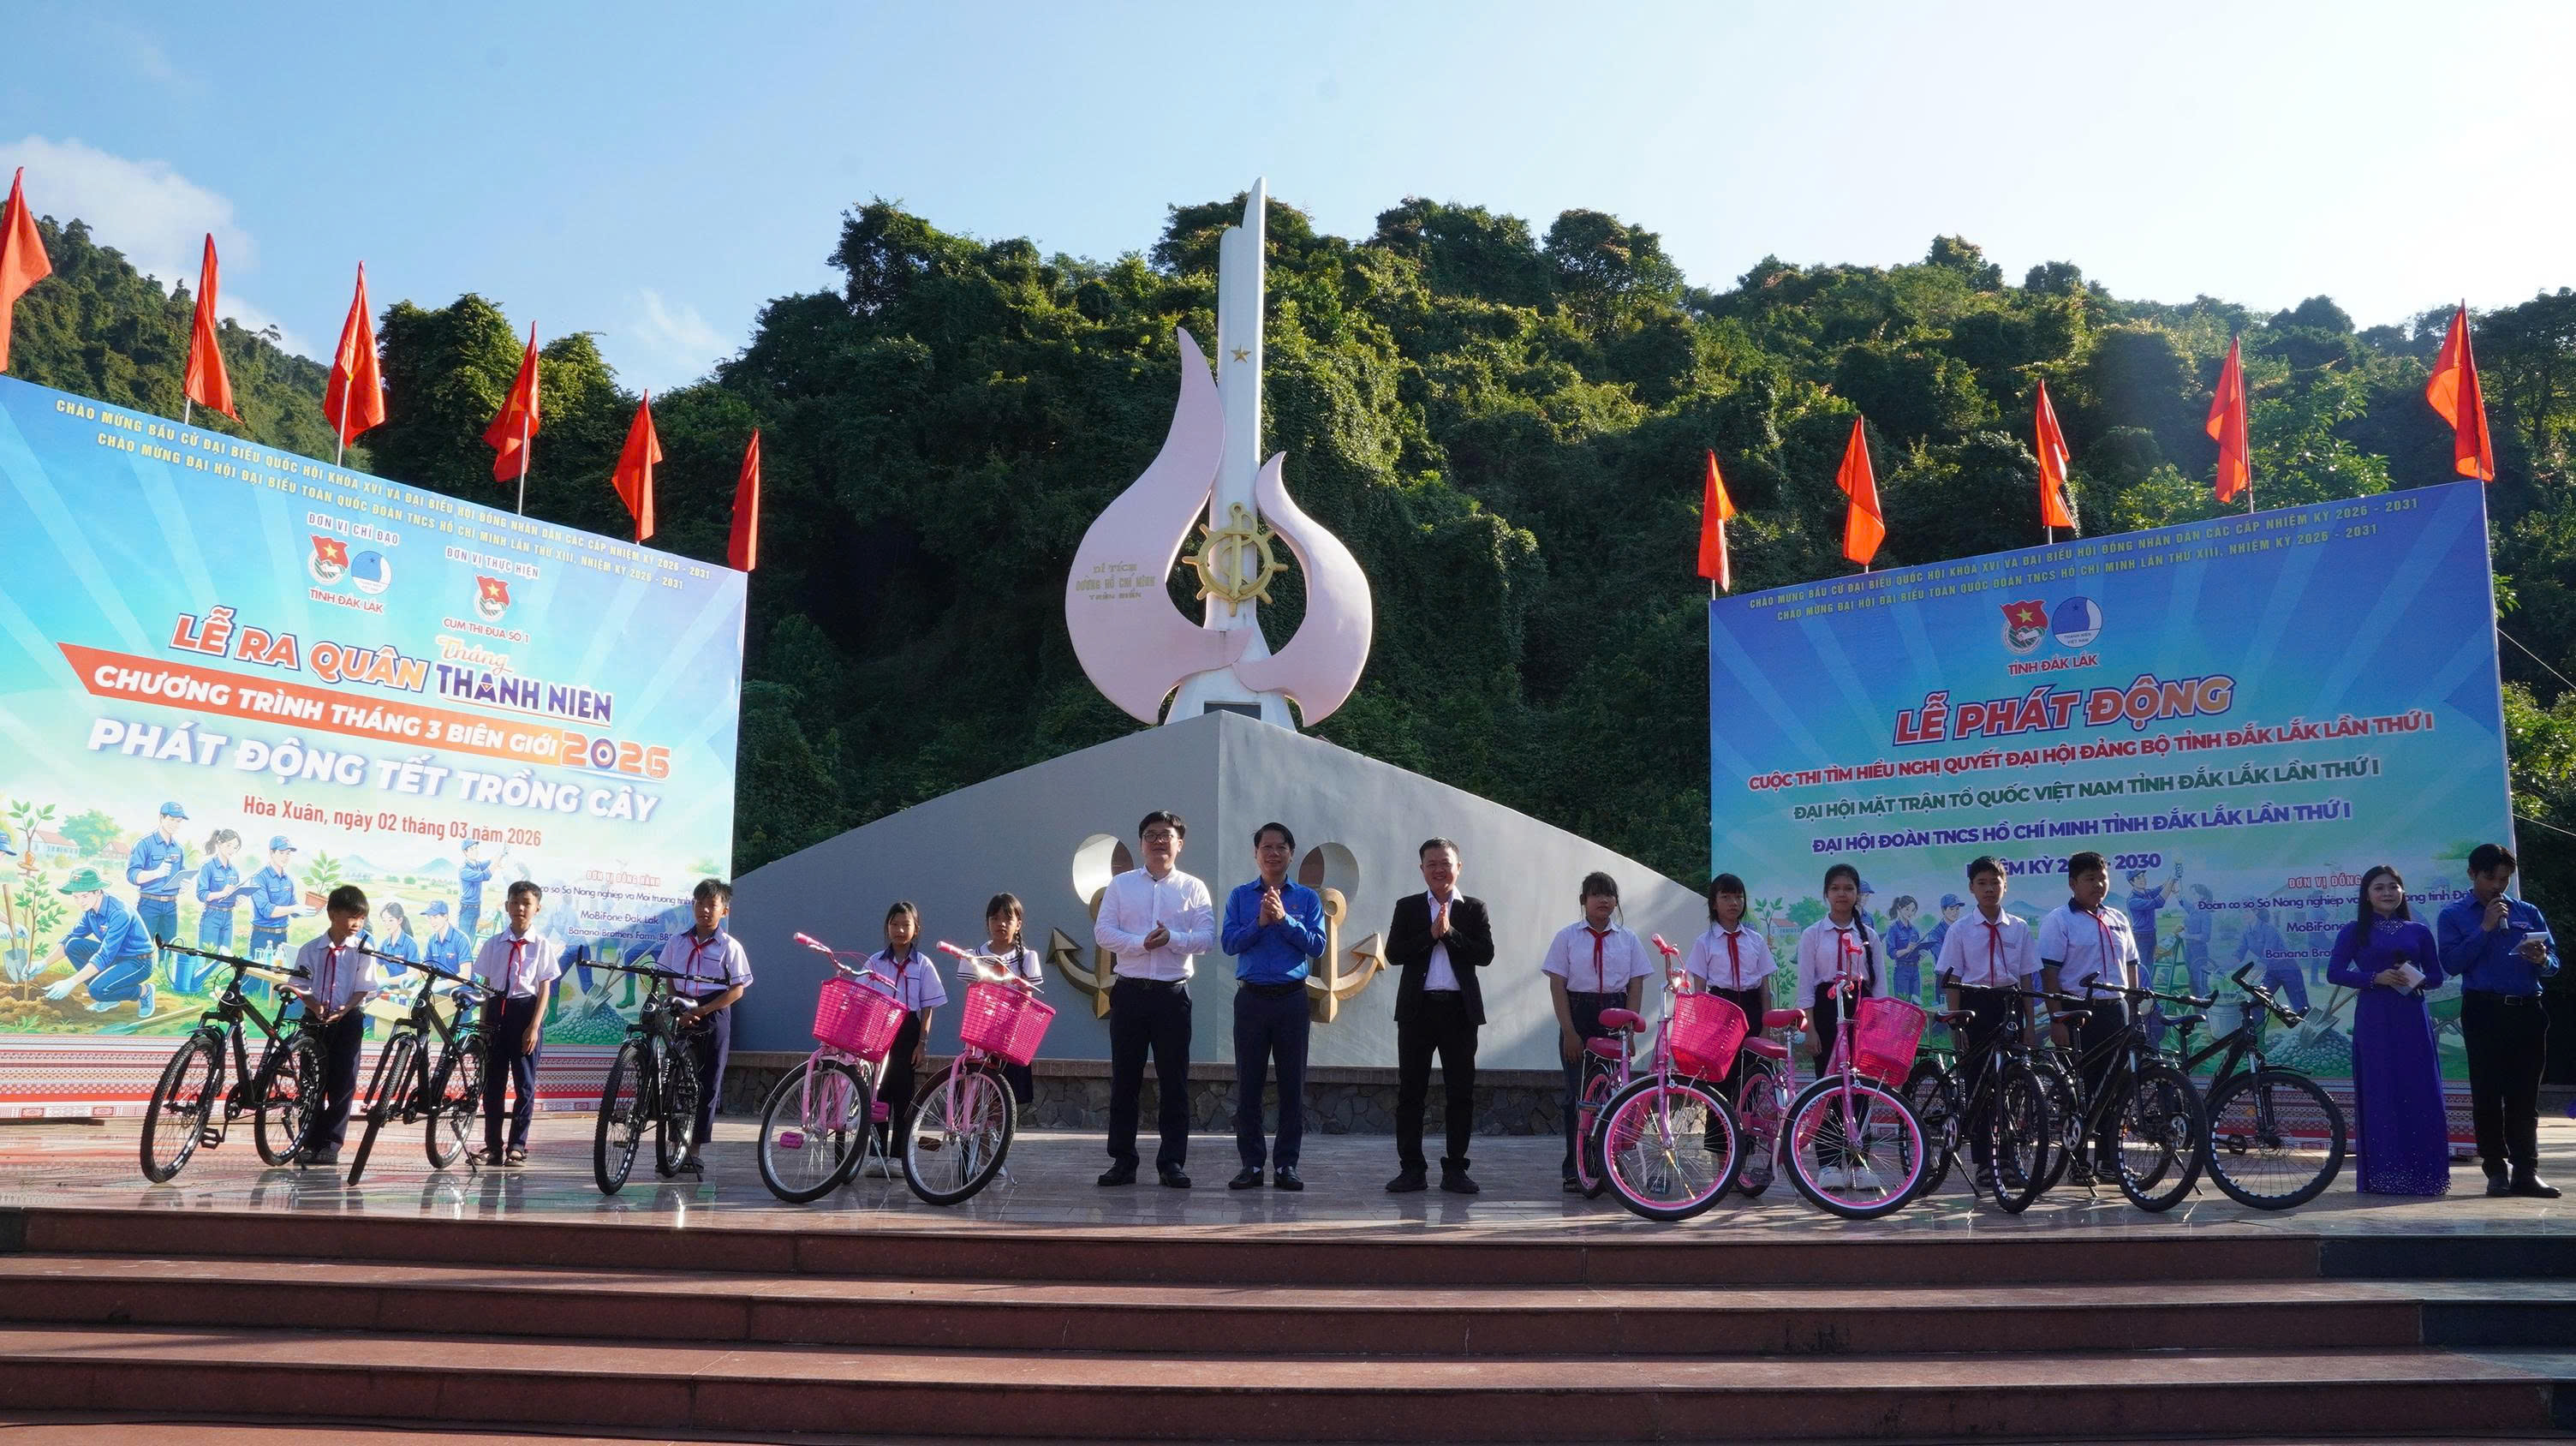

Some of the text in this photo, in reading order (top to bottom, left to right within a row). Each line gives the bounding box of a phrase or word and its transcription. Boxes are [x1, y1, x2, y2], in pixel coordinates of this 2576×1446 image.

[57, 398, 94, 421] CHÀO
[101, 409, 142, 433] MỪNG
[203, 436, 225, 455] ĐẠI
[266, 451, 298, 473] QUỐC
[303, 462, 322, 481] HỘI
[363, 478, 382, 495] XVI
[386, 483, 400, 499] VÀ
[404, 489, 424, 507] ĐẠI
[457, 502, 474, 520] HỘI
[610, 543, 639, 562] NHIỆM
[658, 556, 678, 571] 2026
[689, 564, 710, 580] 2031
[98, 433, 135, 453] CHÀO
[140, 444, 180, 464] MỪNG
[186, 456, 208, 472] ĐẠI
[213, 462, 236, 479] HỘI
[242, 469, 262, 486] ĐẠI
[337, 492, 367, 511] QUỐC
[408, 511, 435, 528] TNCS
[480, 529, 507, 546] MINH
[581, 555, 611, 572] NHIỆM
[630, 567, 651, 582] 2026
[663, 575, 683, 589] 2031
[308, 513, 331, 528] ĐƠN
[337, 520, 347, 535] VỊ
[377, 530, 397, 545] ĐẠO
[447, 547, 539, 578] ĐƠN VỊ THỰC HIỆN
[170, 603, 428, 691] LỄ RA QUÂN
[468, 624, 482, 634] THI
[485, 627, 505, 638] ĐUA
[438, 640, 512, 675] Tháng
[2008, 660, 2037, 674] TỈNH
[93, 664, 557, 756] CHƯƠNG TRÌNH THÁNG 3 BIÊN GIỚI
[437, 664, 540, 710] THANH
[1894, 676, 2235, 744] LỄ PHÁT ĐỘNG
[89, 719, 659, 822] PHÁT ĐỘNG TẾT TRỒNG CÂY
[561, 730, 671, 780] 2026
[1749, 712, 2431, 791] CUỘC THI TÌM HIỂU NGHỊ QUYẾT ĐẠI HỘI ĐẢNG BỘ TỈNH ĐẮK LẮK LẦN THỨ I
[1793, 757, 2377, 822] ĐẠI HỘI MẶT TRẬN TỔ QUỐC VIỆT NAM TỈNH ĐẮK LẮK LẦN THỨ I
[244, 796, 541, 847] Hòa Xuân, ngày 02 tháng 03 năm 2026
[1813, 800, 2350, 855] ĐẠI HỘI ĐOÀN TNCS HỒ CHÍ MINH TỈNH ĐẮK LẮK LẦN THỨ I
[2029, 855, 2054, 875] KỲ
[2115, 852, 2161, 869] 2030
[2288, 877, 2311, 888] ĐƠN
[2315, 876, 2327, 890] VỊ
[568, 927, 654, 940] Banana Brothers Farm
[581, 911, 622, 922] MoBiFone
[2265, 950, 2308, 959] Banana
